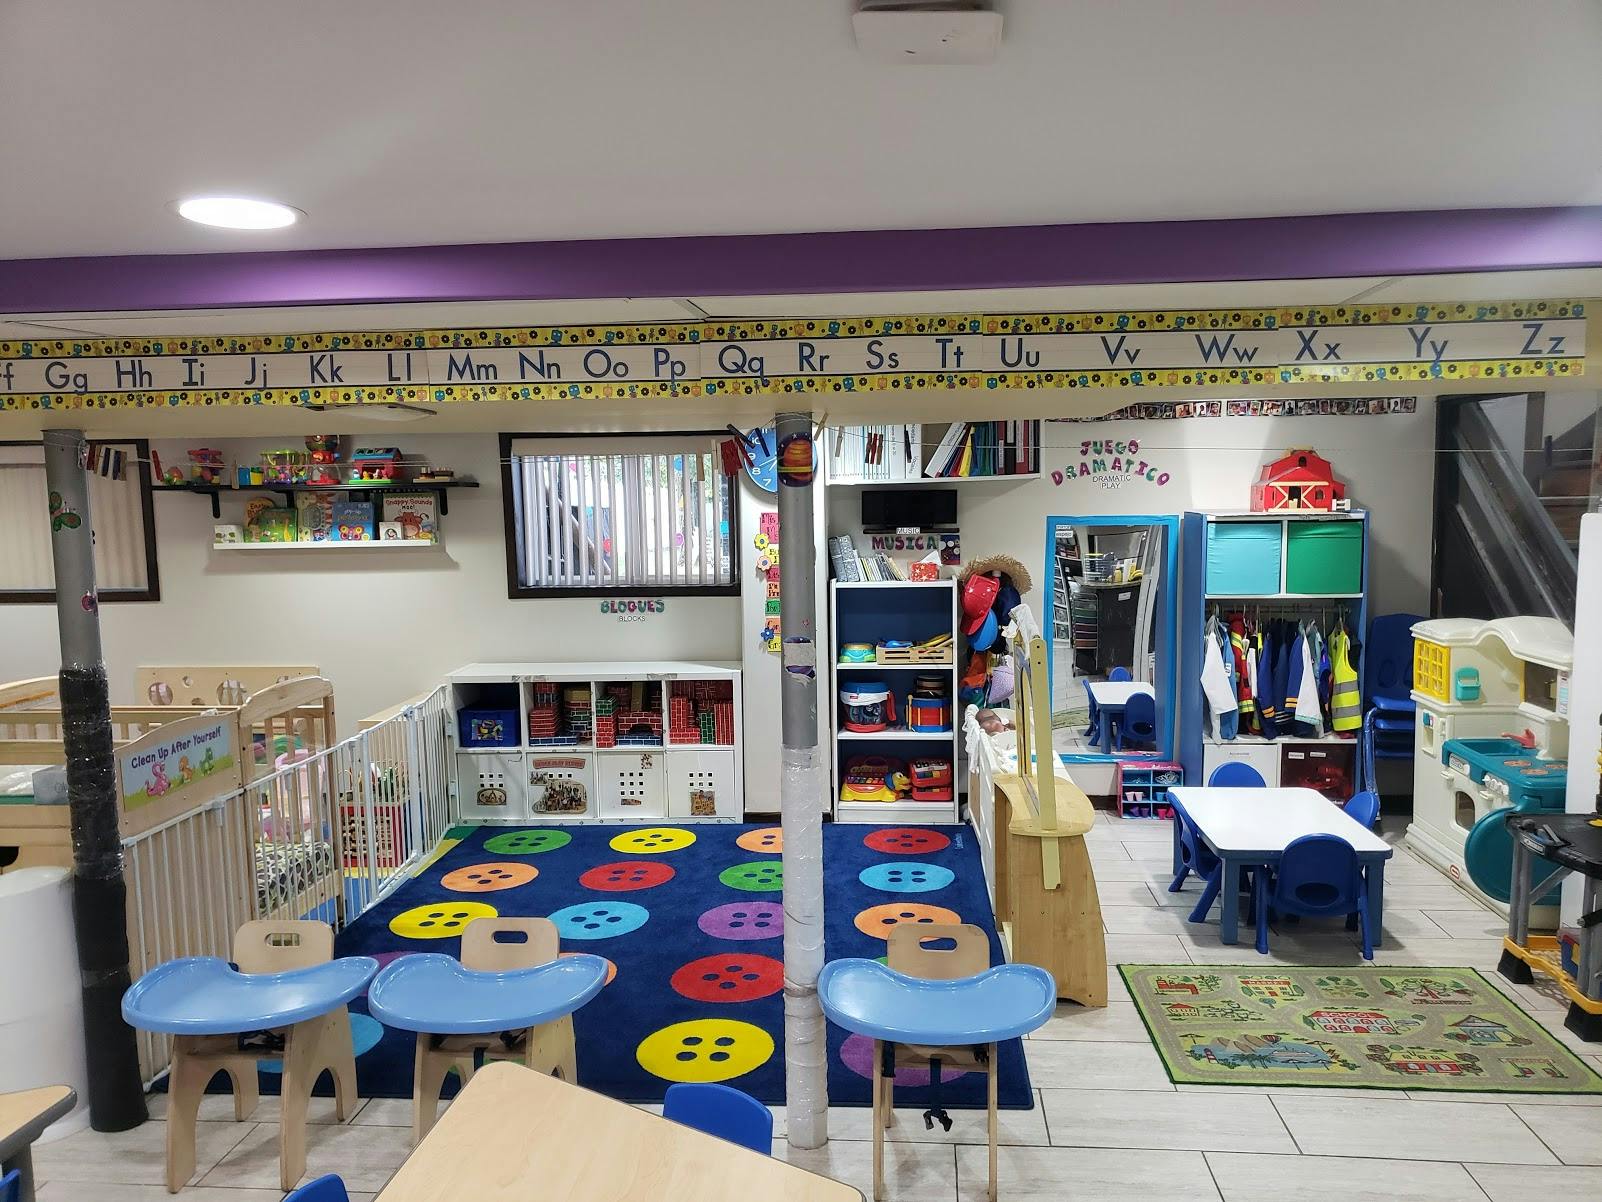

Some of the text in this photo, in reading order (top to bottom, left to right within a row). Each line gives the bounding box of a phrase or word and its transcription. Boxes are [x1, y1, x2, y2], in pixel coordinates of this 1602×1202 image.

[0, 363, 15, 391] f
[45, 361, 89, 396] Gg
[115, 359, 153, 388] Hh
[182, 358, 206, 387] Ii
[244, 356, 268, 391] Jj
[309, 354, 345, 384] Kk
[447, 352, 499, 382] Mm
[519, 350, 562, 380] Nn
[583, 349, 630, 379] Oo
[654, 348, 686, 386] Pp
[718, 344, 766, 384] Qq
[799, 342, 830, 372] Rr
[866, 340, 900, 370] Ss
[935, 338, 964, 368] Tt
[1000, 338, 1040, 368] Uu
[1099, 335, 1142, 365] Vv
[1194, 334, 1260, 364] Ww
[1294, 329, 1342, 361] Xx
[1407, 327, 1449, 368] Yy
[1520, 323, 1566, 355] Zz
[1080, 439, 1139, 456] JUEGO
[1050, 457, 1170, 486] DRAMATICO
[1092, 475, 1132, 483] DRAMATIC
[871, 535, 938, 550] MUSICA
[600, 600, 665, 613] BLOQUES
[131, 726, 222, 769] Clean Up After Yourself
